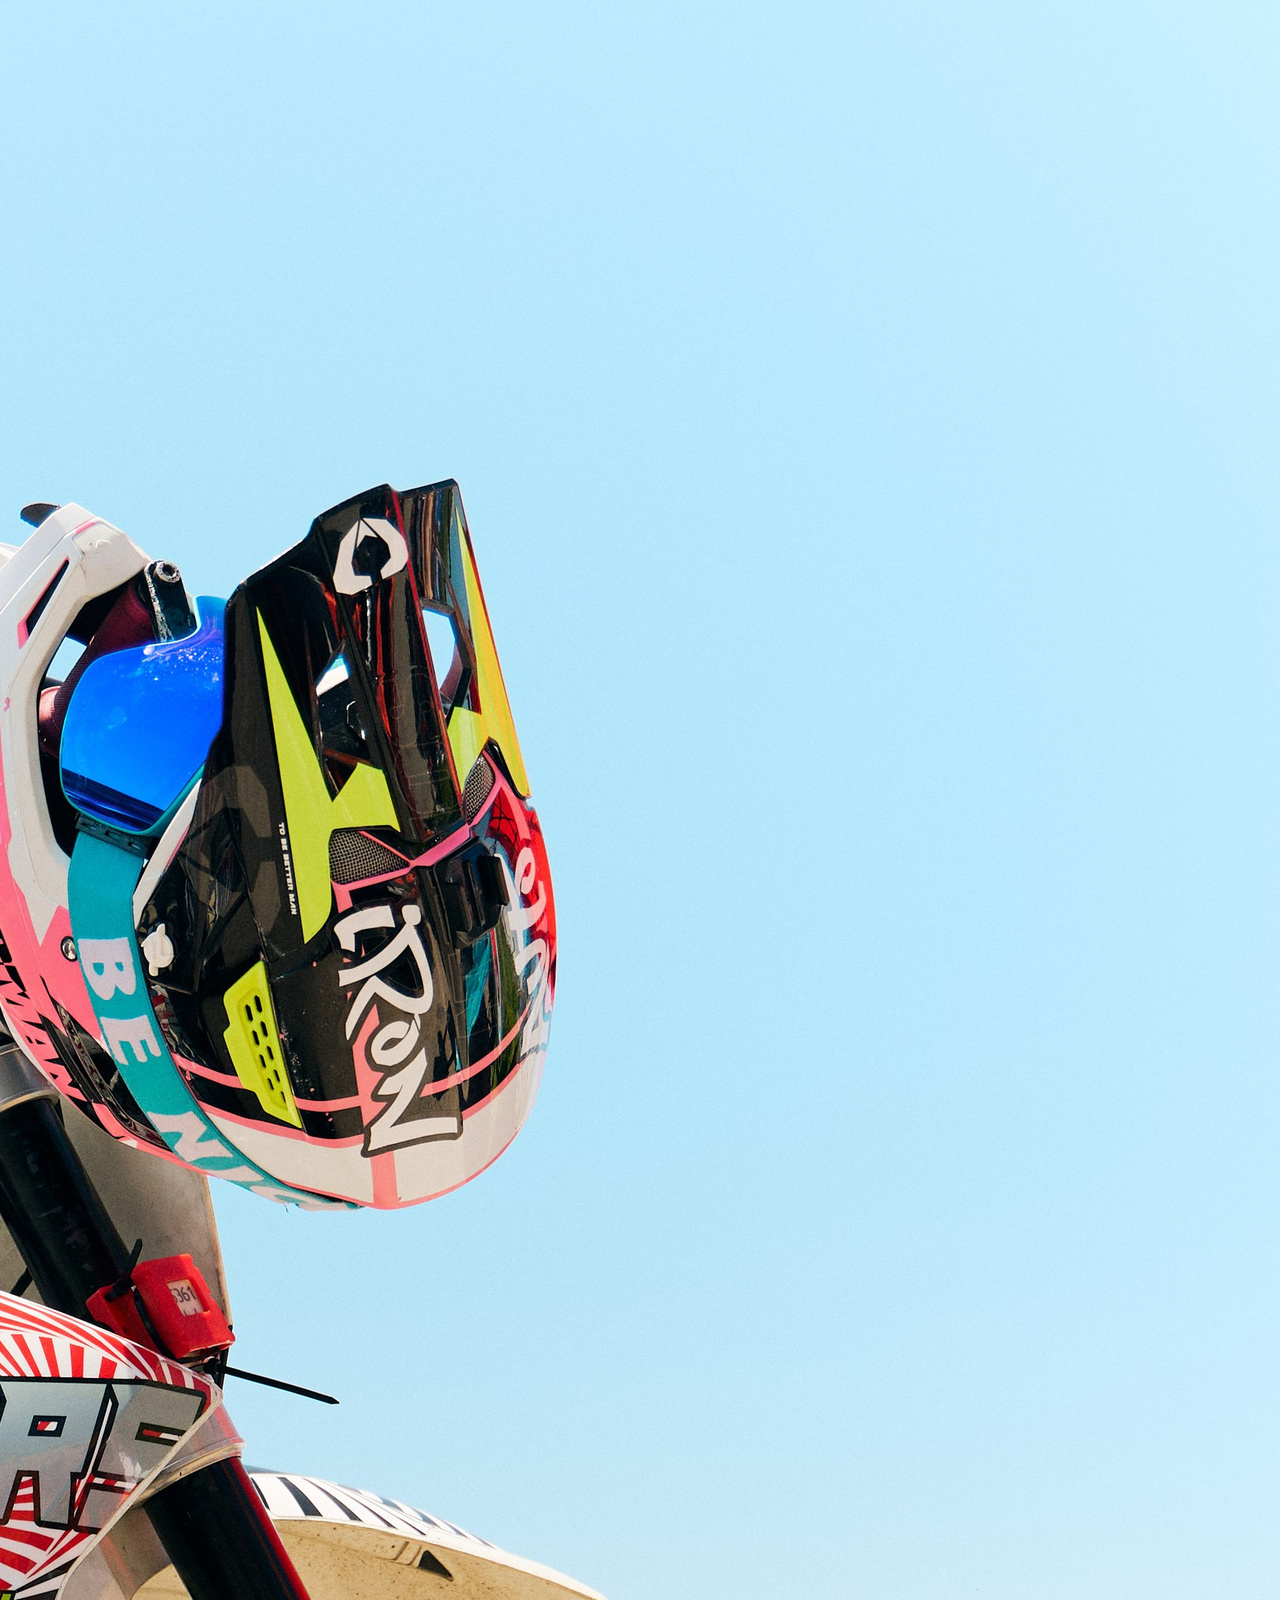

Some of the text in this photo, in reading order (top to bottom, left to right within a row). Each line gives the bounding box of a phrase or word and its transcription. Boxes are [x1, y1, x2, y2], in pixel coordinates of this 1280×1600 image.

[278, 822, 297, 915] TO BE BETTER MAN
[77, 936, 163, 1066] BE
